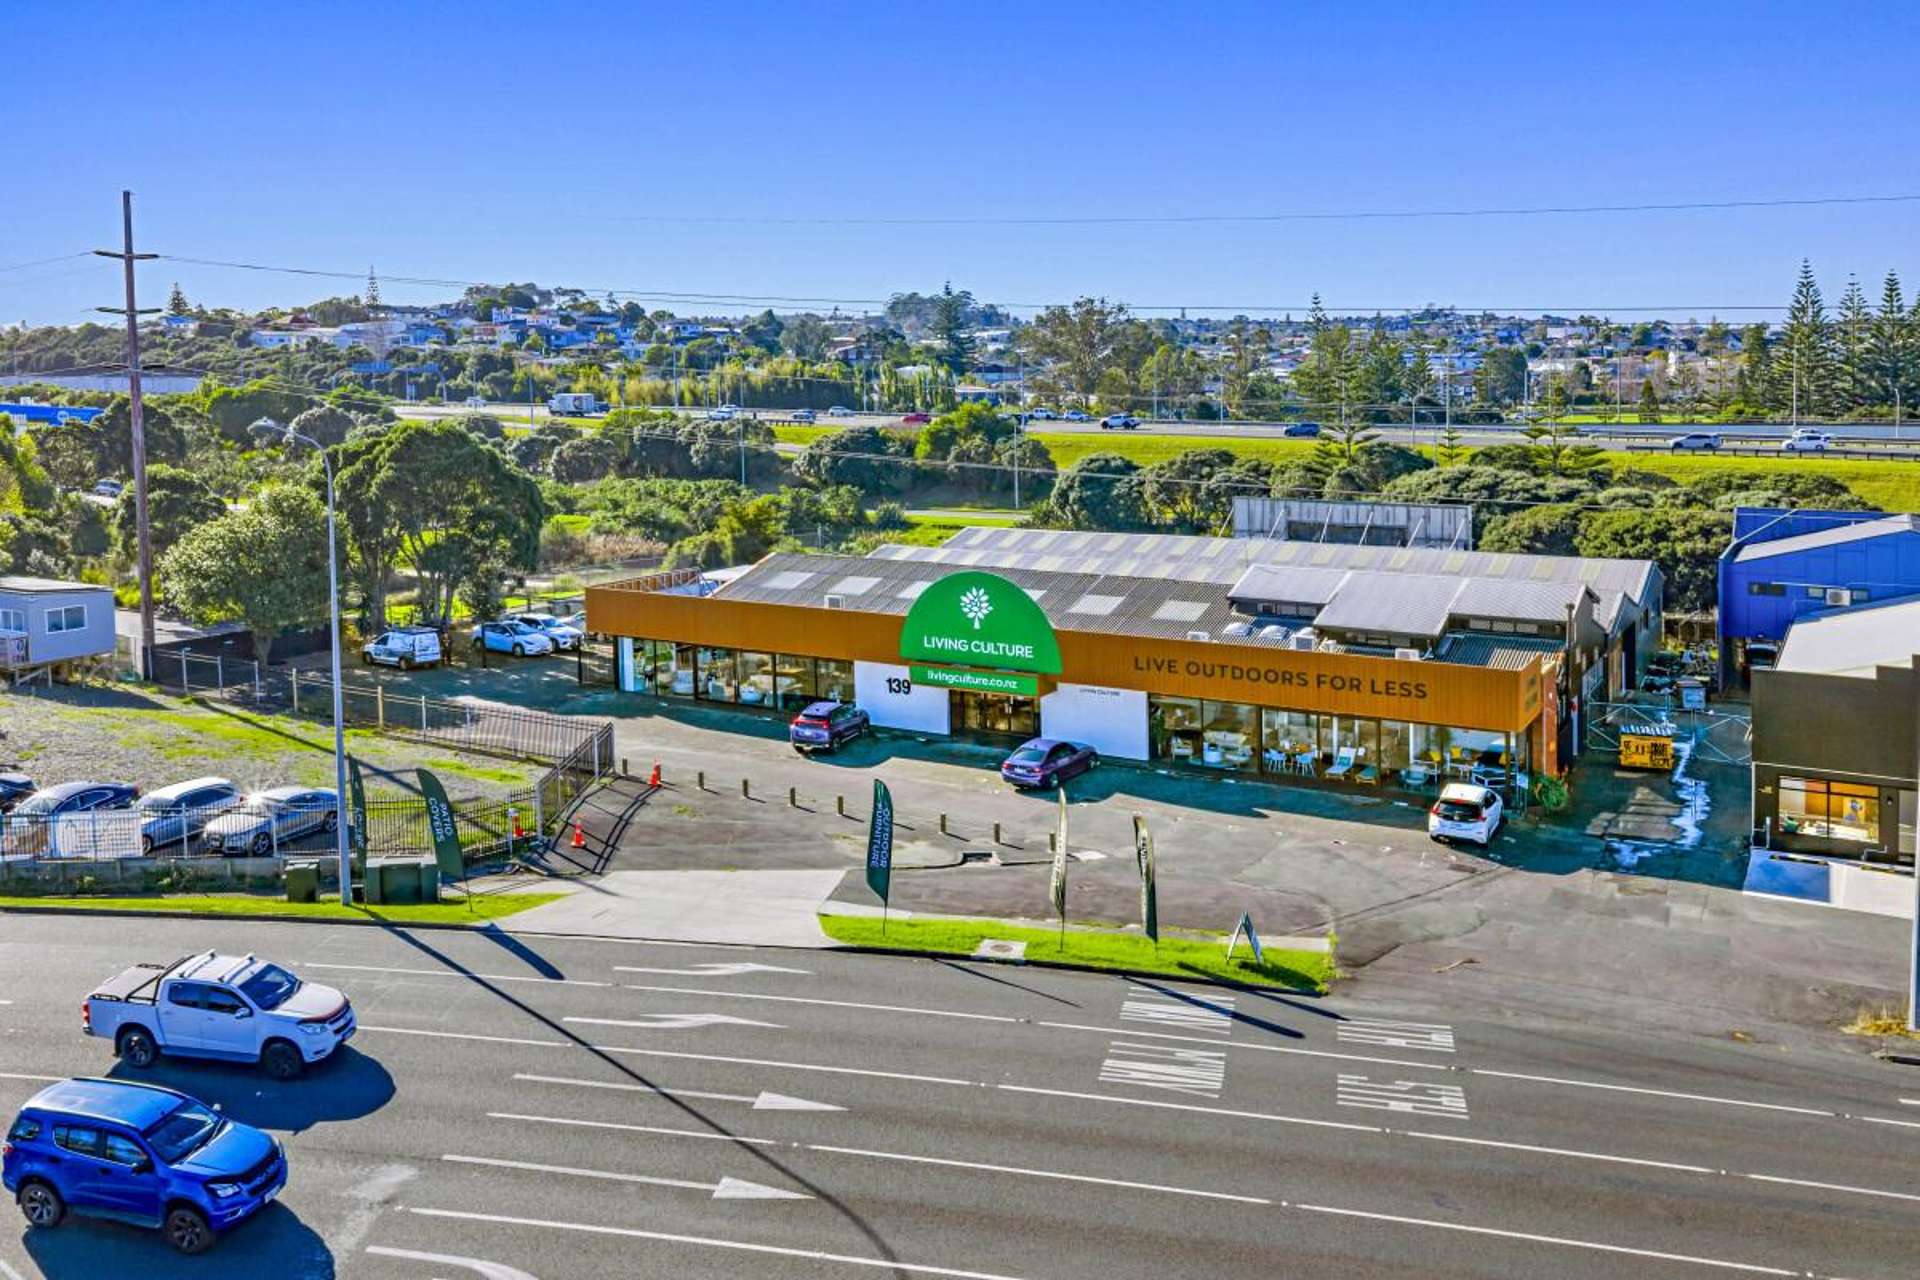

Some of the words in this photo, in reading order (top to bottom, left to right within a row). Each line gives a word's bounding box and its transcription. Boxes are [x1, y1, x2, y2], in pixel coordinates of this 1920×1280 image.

[924, 635, 968, 652] LIVING
[970, 641, 1034, 658] CULTURE
[886, 677, 911, 696] 139
[927, 670, 1018, 689] livingculture.co.nz
[1134, 656, 1178, 675] LIVE
[1185, 661, 1308, 687] OUTDOORS
[1316, 672, 1362, 693] FOR
[1371, 678, 1427, 699] LESS
[429, 799, 445, 842] COVERS
[440, 803, 453, 837] PATIO
[870, 803, 882, 868] FURNITURE
[879, 806, 890, 868] OUTDOOR
[1337, 1074, 1470, 1121] STH
